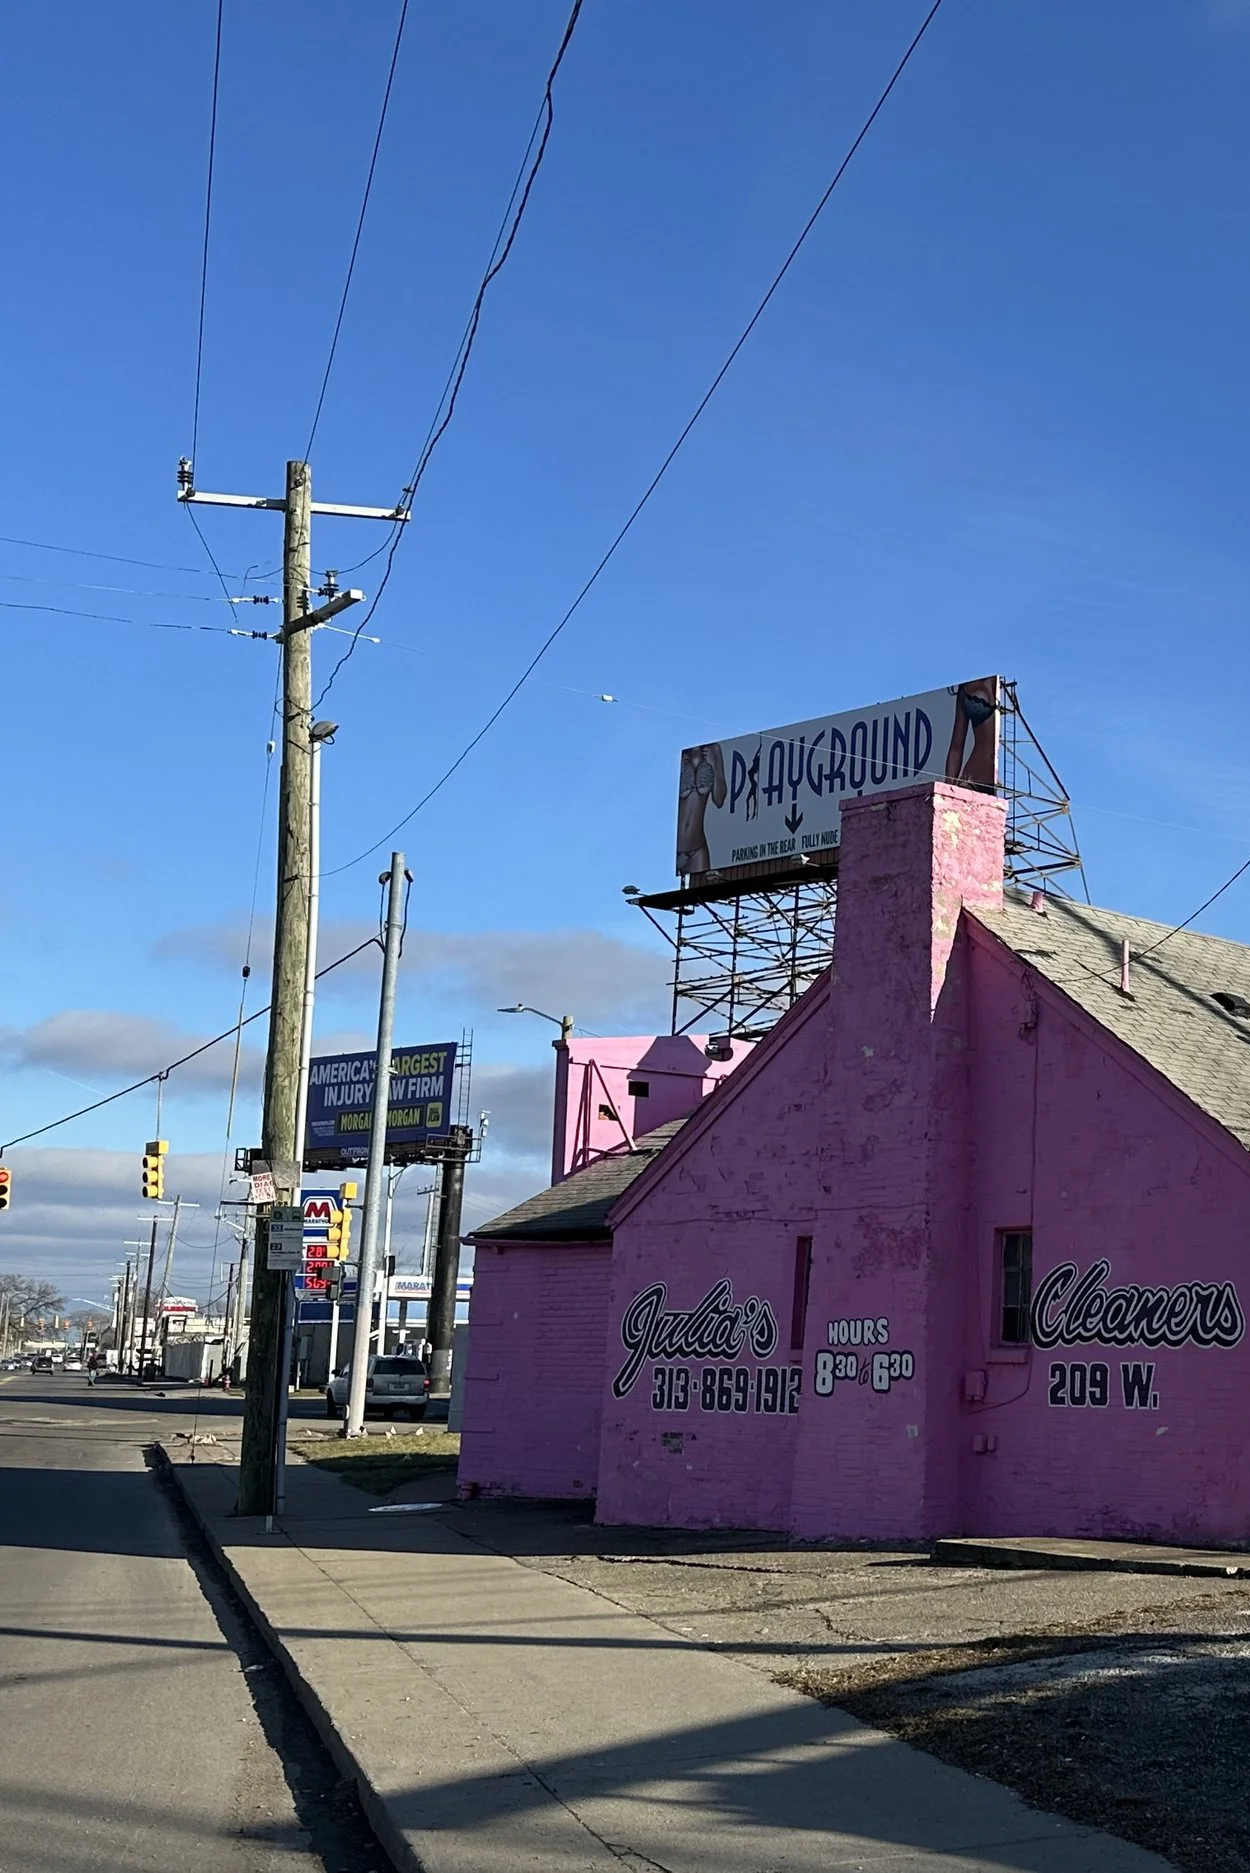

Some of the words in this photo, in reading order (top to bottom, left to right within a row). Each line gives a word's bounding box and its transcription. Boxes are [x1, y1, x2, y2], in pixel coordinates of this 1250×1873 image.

[731, 845, 758, 862] PARKING
[759, 843, 767, 857] IN
[767, 841, 779, 855] THE
[780, 838, 796, 853] REAR
[801, 833, 820, 849] FULLY
[821, 829, 839, 845] NUDE
[391, 1052, 447, 1077] ARGEST
[324, 1082, 374, 1107] INJURY
[388, 1079, 406, 1100] AW
[408, 1075, 444, 1099] FIRM
[396, 1281, 432, 1290] MARAT
[1030, 1257, 1246, 1351] Cleaners
[612, 1278, 778, 1399] Julia's
[827, 1317, 890, 1346] HOURS
[858, 1359, 871, 1385] to
[1047, 1361, 1111, 1408] 209
[1120, 1361, 1160, 1410] W.
